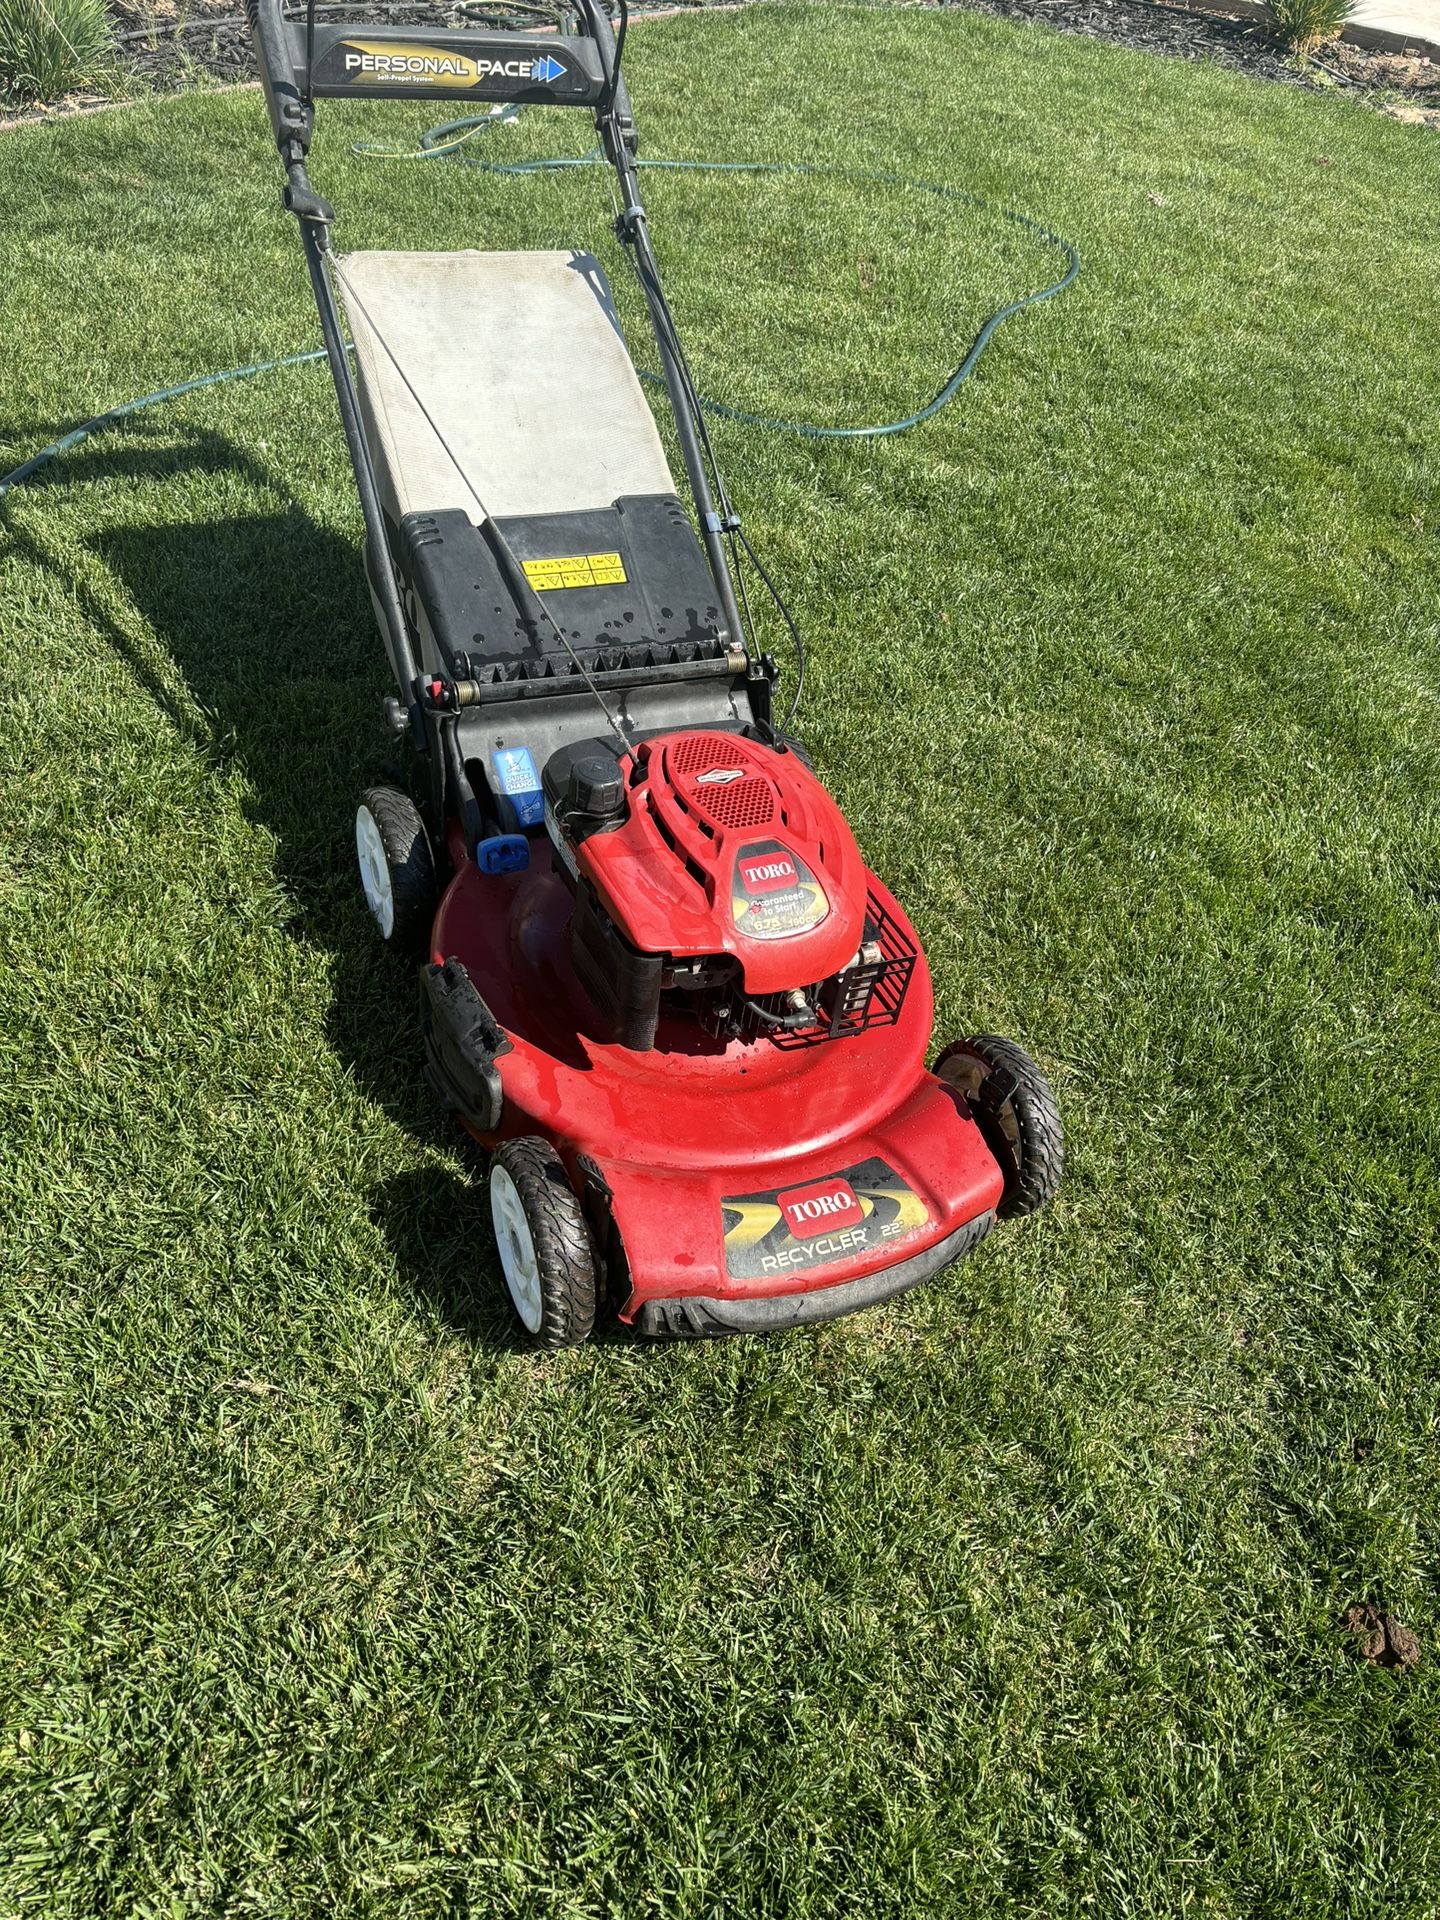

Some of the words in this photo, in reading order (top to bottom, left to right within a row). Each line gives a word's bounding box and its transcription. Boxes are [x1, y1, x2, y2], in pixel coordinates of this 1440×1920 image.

[345, 54, 469, 75] PERSONAL
[477, 59, 532, 77] PACE
[377, 73, 412, 83] Self-Propel
[412, 75, 434, 83] System
[505, 780, 537, 790] CHANGE
[745, 861, 793, 883] TORO
[774, 902, 797, 914] Start
[753, 917, 781, 931] 675
[787, 1191, 851, 1223] TORO
[760, 1230, 868, 1272] RECYCLER
